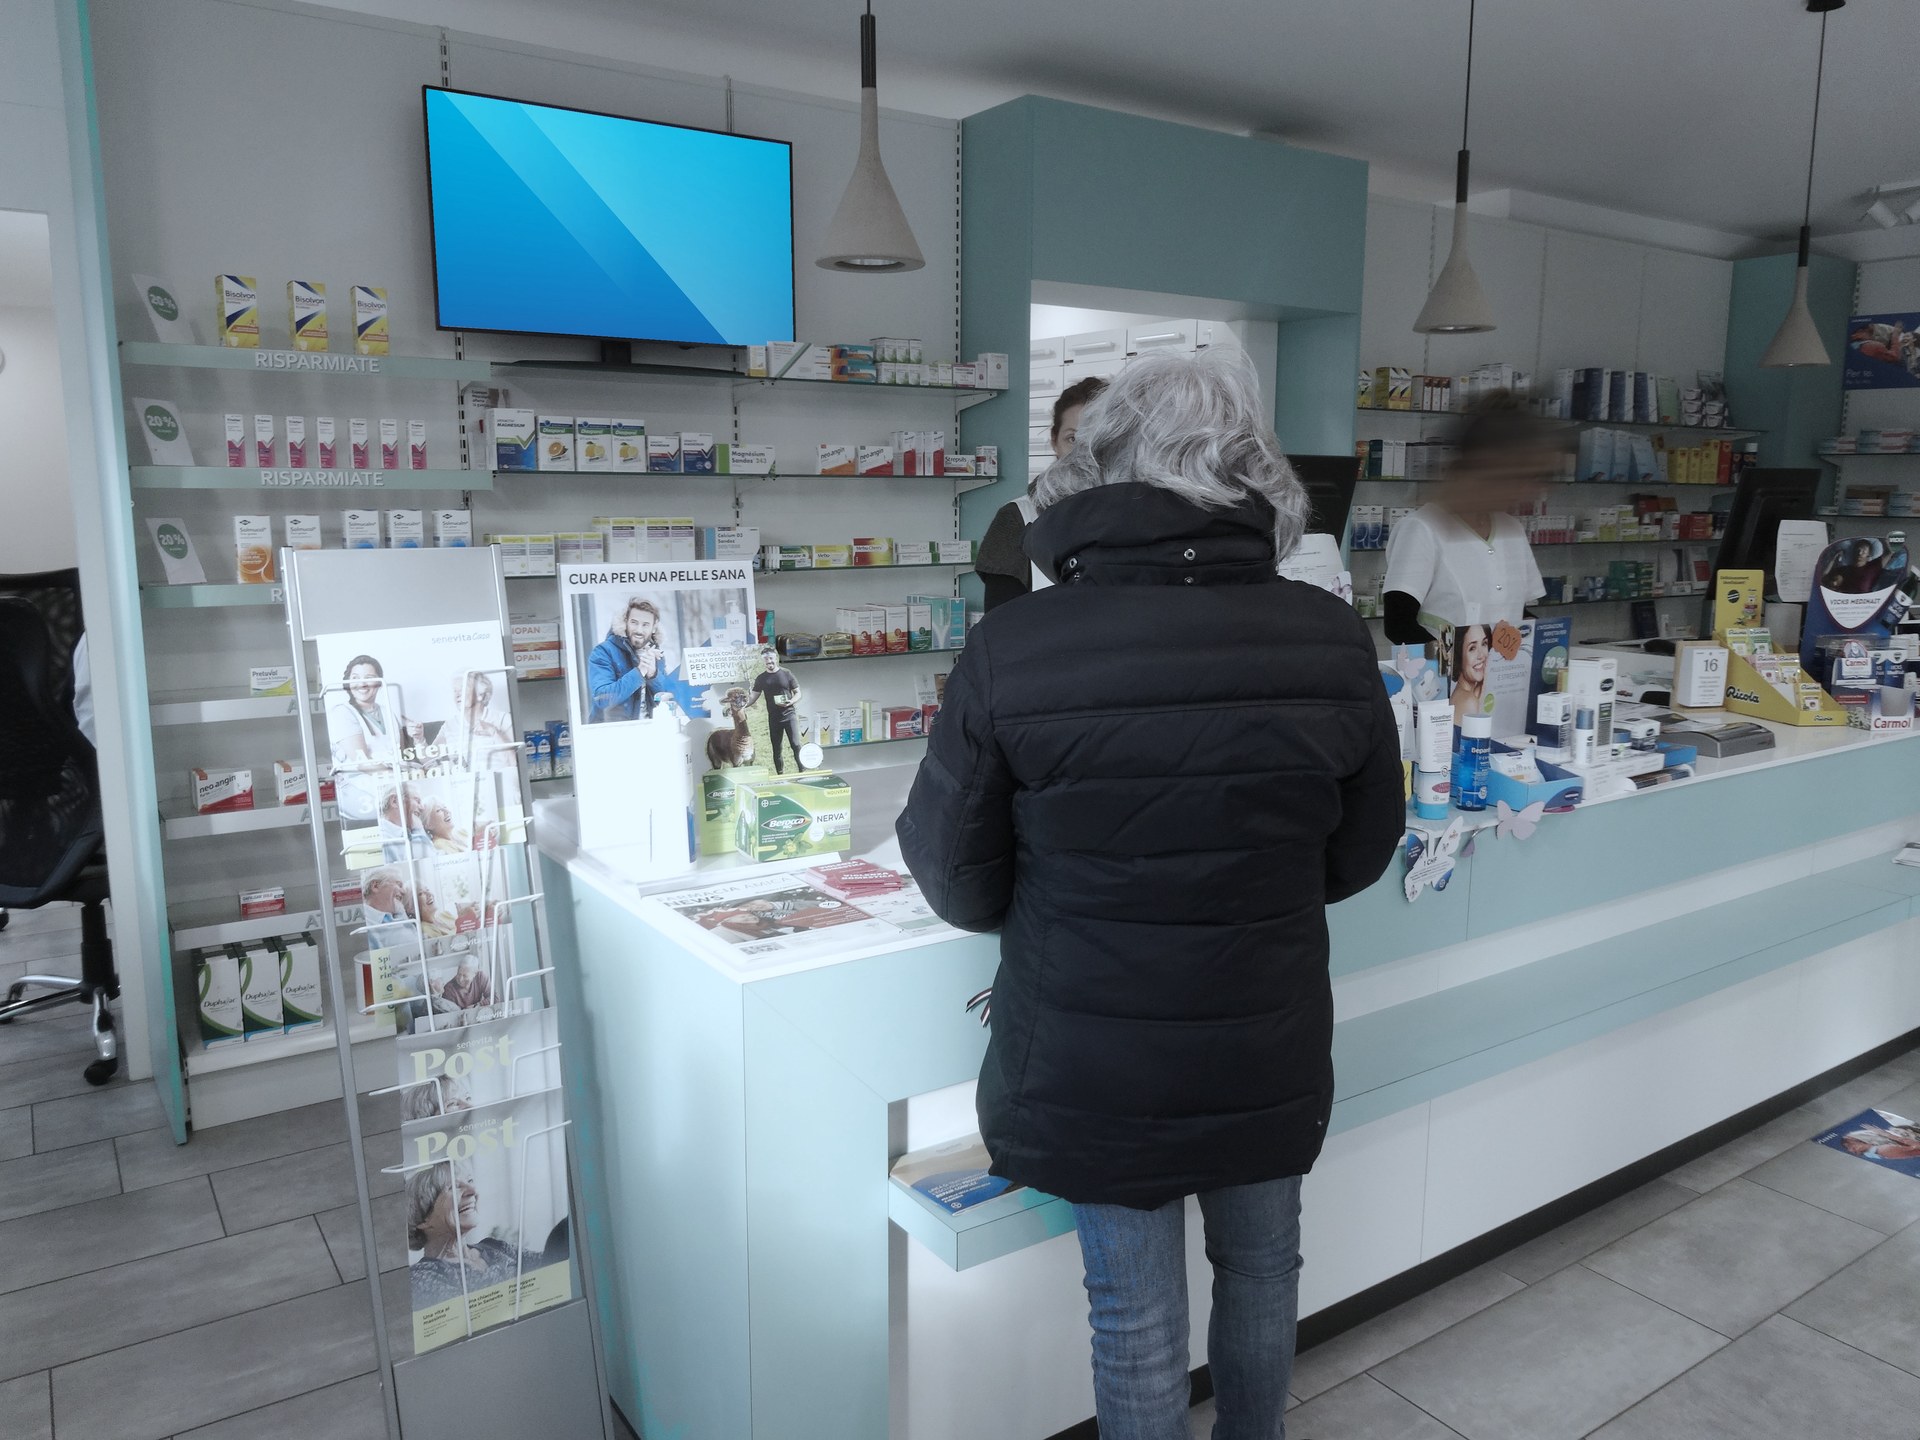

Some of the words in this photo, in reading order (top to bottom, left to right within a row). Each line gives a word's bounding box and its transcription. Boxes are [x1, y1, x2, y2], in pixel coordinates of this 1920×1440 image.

[225, 290, 256, 300] Bisolvon
[295, 295, 325, 305] Bisolvon
[357, 300, 387, 310] Bisolvon
[255, 352, 380, 373] RISPARMIATE
[260, 470, 385, 487] RISPARMIATE
[569, 573, 608, 585] CURA
[611, 572, 636, 583] PER
[639, 571, 668, 582] UNA
[671, 570, 708, 581] PELLE
[711, 569, 746, 581] SANA
[512, 626, 541, 635] IOPAN
[431, 634, 472, 645] senevita
[690, 663, 706, 671] PER
[709, 662, 735, 670] NERVI
[1704, 659, 1718, 672] 16
[1845, 659, 1868, 667] Carmol
[699, 671, 736, 679] MUSCOLI
[1726, 686, 1760, 704] Ricola
[1873, 717, 1911, 729] Carmol
[768, 818, 805, 828] Berocca
[816, 813, 845, 823] NERVA
[655, 886, 740, 902] FARMACIA
[744, 876, 793, 889] AMICA
[663, 894, 725, 908] NEWS
[456, 1035, 493, 1051] senevita
[410, 1033, 515, 1083] Post
[458, 1117, 497, 1133] senevita
[414, 1116, 520, 1173] Post
[423, 1312, 434, 1321] Una
[434, 1309, 444, 1317] vita
[423, 1313, 447, 1325] massimo
